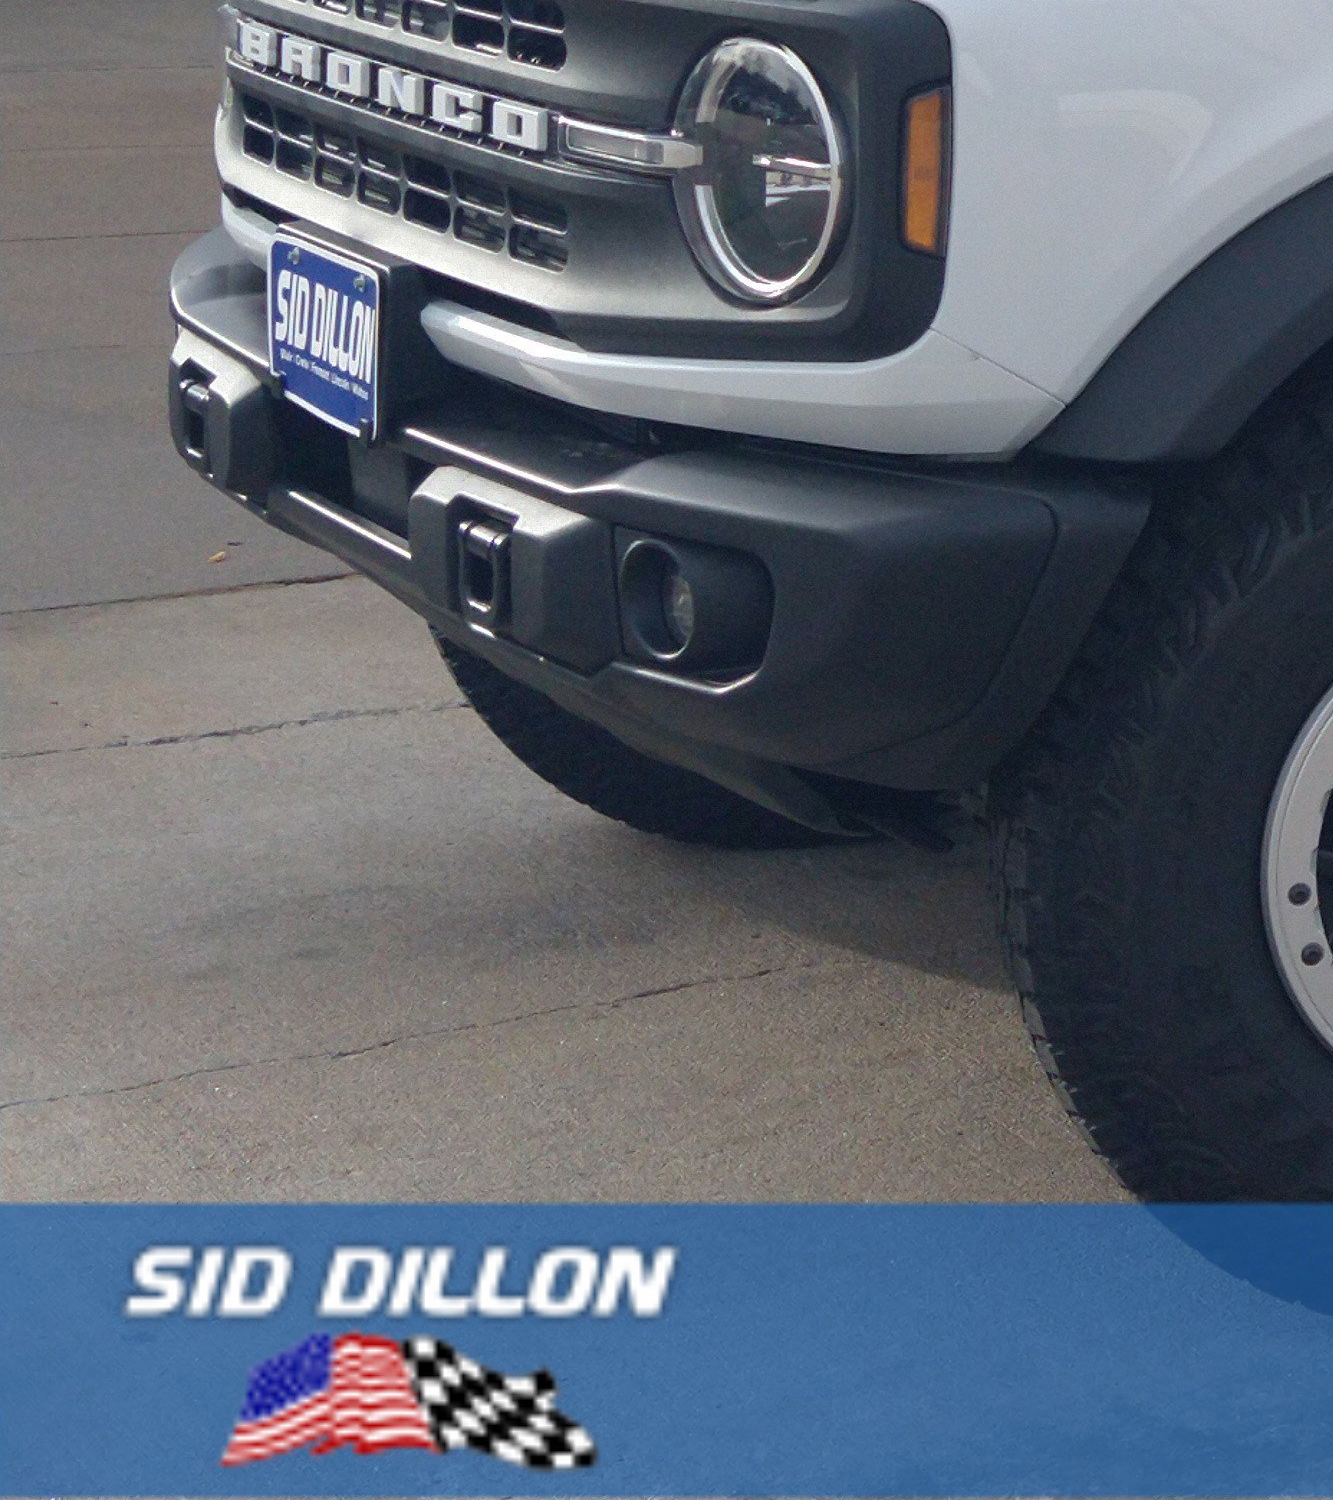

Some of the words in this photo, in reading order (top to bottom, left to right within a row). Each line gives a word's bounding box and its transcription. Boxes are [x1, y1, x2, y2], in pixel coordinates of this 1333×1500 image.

[237, 17, 549, 151] BRONCO
[275, 268, 310, 350] SID
[311, 283, 376, 382] DILLON
